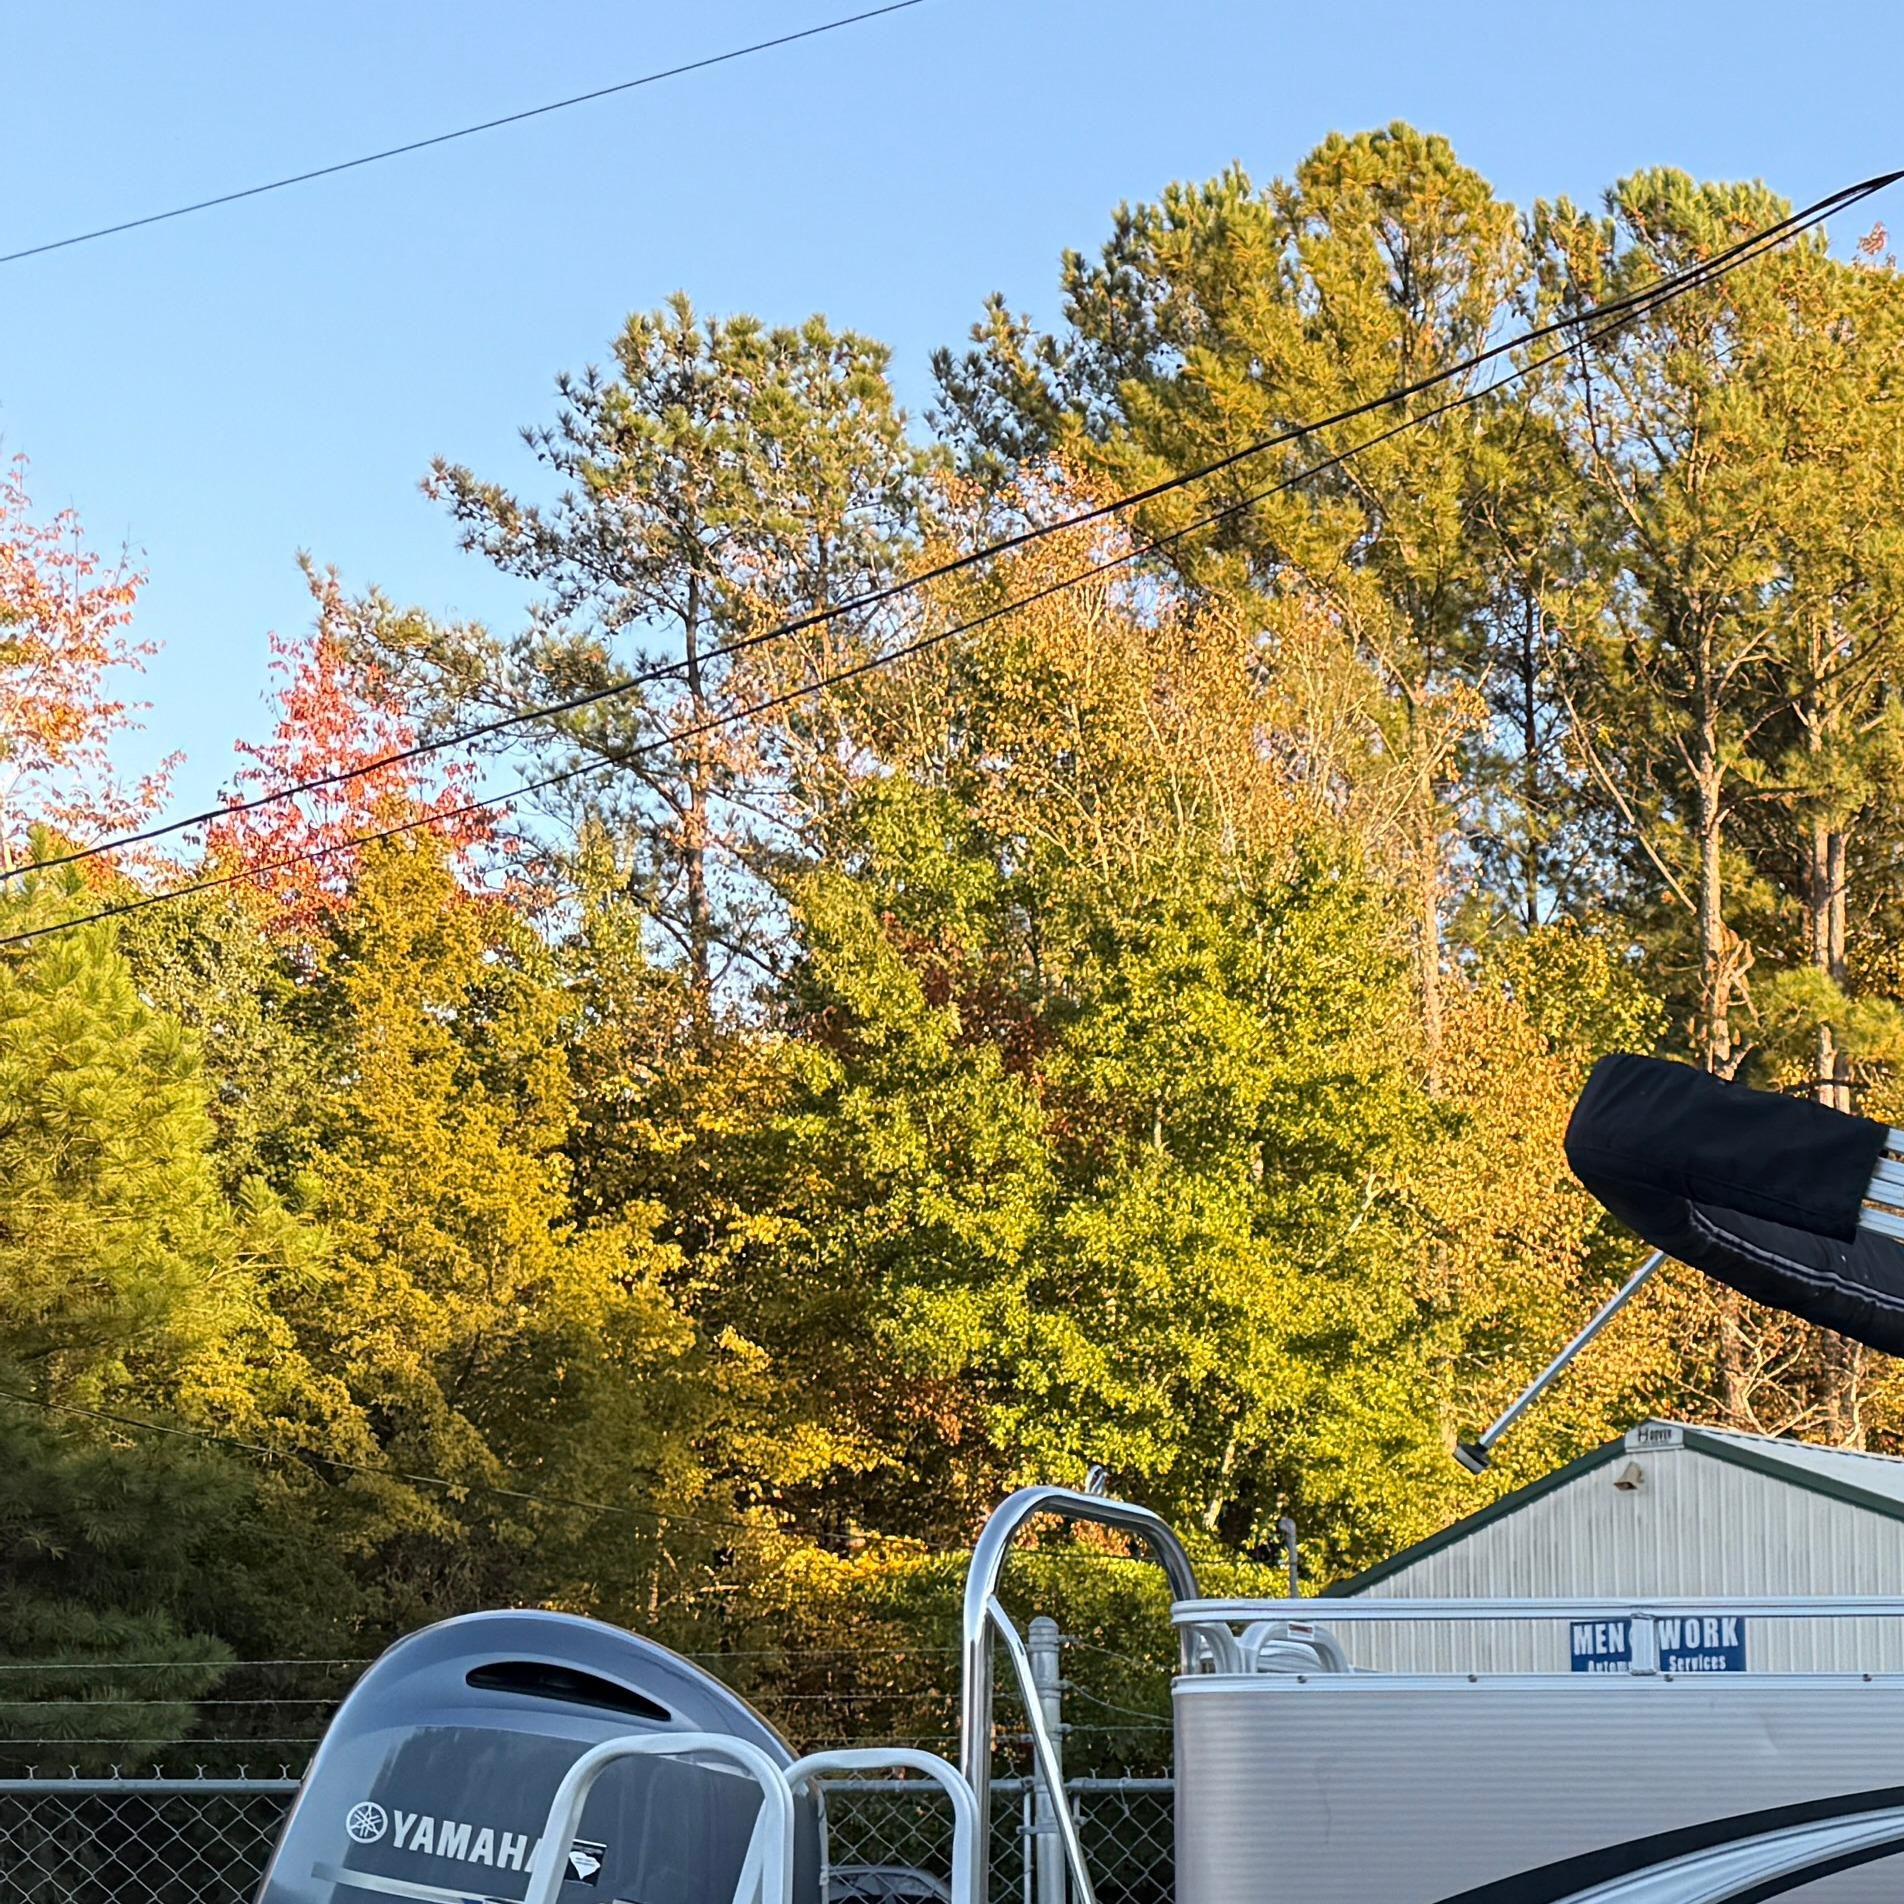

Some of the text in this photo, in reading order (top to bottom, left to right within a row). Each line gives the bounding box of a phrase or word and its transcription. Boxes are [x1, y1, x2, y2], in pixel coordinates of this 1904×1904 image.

[1573, 1622, 1625, 1655] MEN
[1658, 1616, 1739, 1650] WORK
[1588, 1660, 1633, 1673] Autom
[1669, 1654, 1727, 1672] Services
